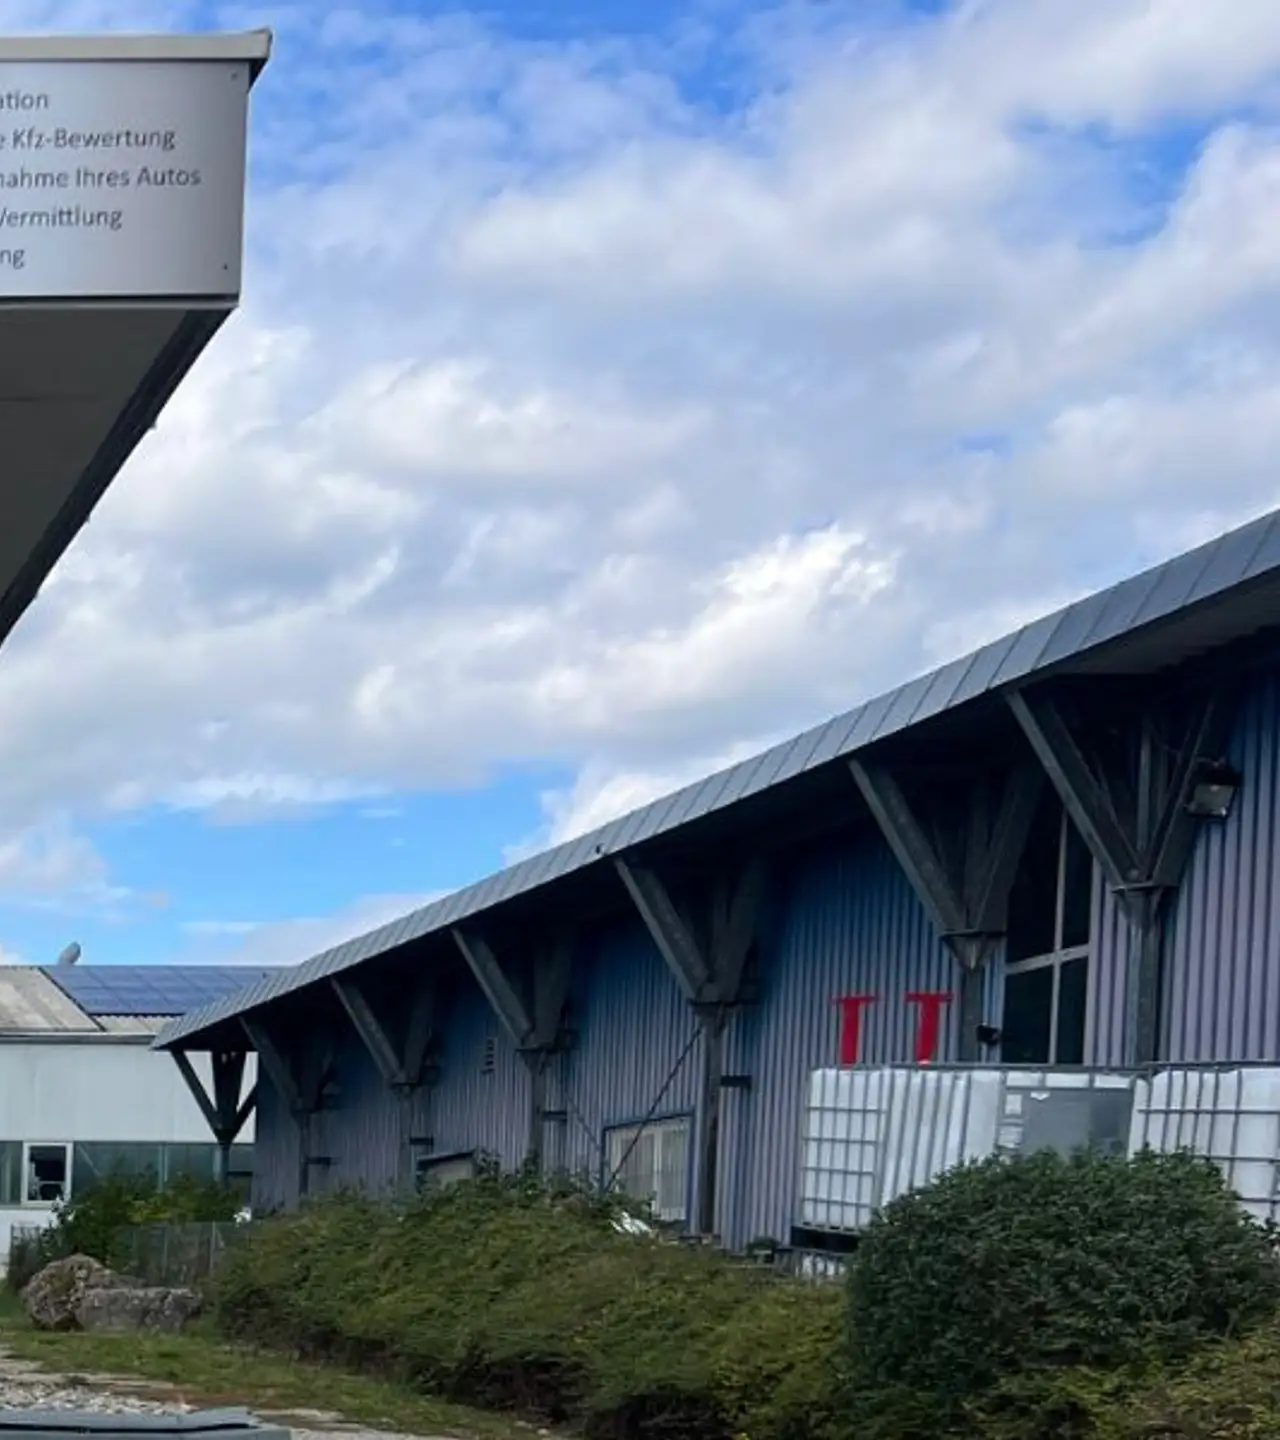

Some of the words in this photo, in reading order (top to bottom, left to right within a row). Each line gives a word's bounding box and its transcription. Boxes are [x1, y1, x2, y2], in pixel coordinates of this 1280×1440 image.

[12, 126, 176, 151] Kfz-Bewertung
[75, 166, 130, 188] Ihres
[137, 165, 202, 186] Autos
